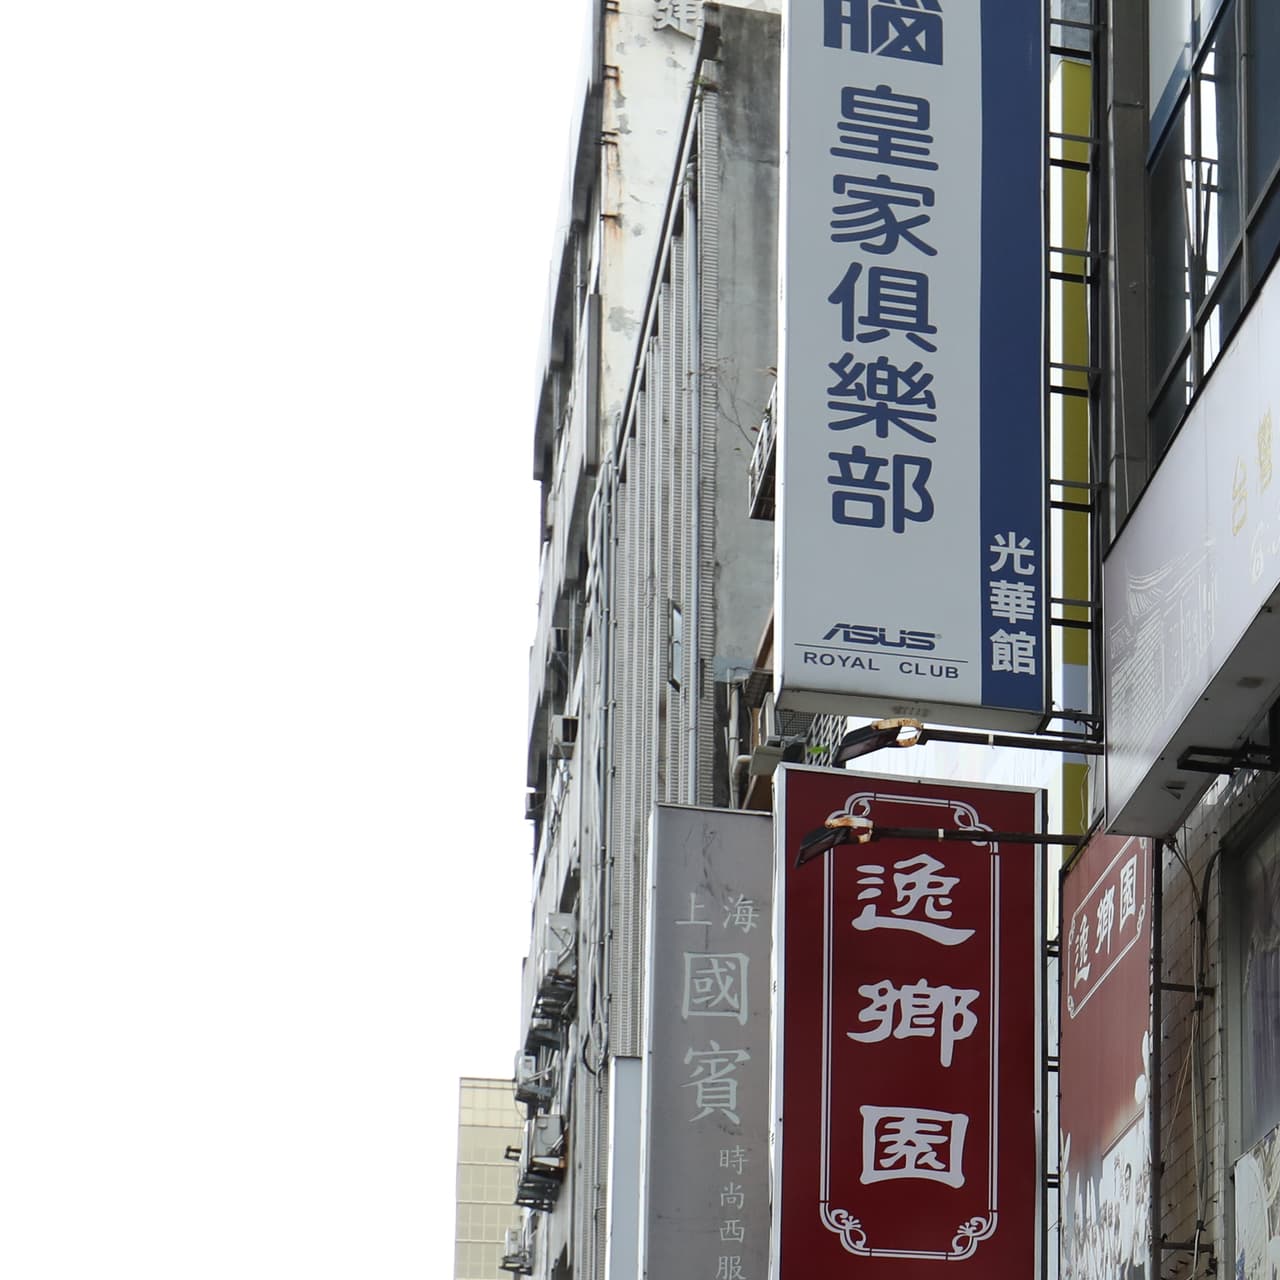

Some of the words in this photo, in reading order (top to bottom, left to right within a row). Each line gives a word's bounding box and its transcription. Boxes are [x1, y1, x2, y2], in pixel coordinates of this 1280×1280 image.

[827, 84, 939, 534] 皇家俱樂部
[803, 650, 880, 673] ROYAL
[898, 660, 960, 680] CLUB
[822, 622, 936, 652] ASUS
[988, 531, 1037, 676] 光華館
[674, 894, 761, 932] 上海
[1073, 853, 1138, 990] 逸鄉園
[679, 949, 750, 1126] 國賓
[846, 852, 980, 1189] 逸鄉園
